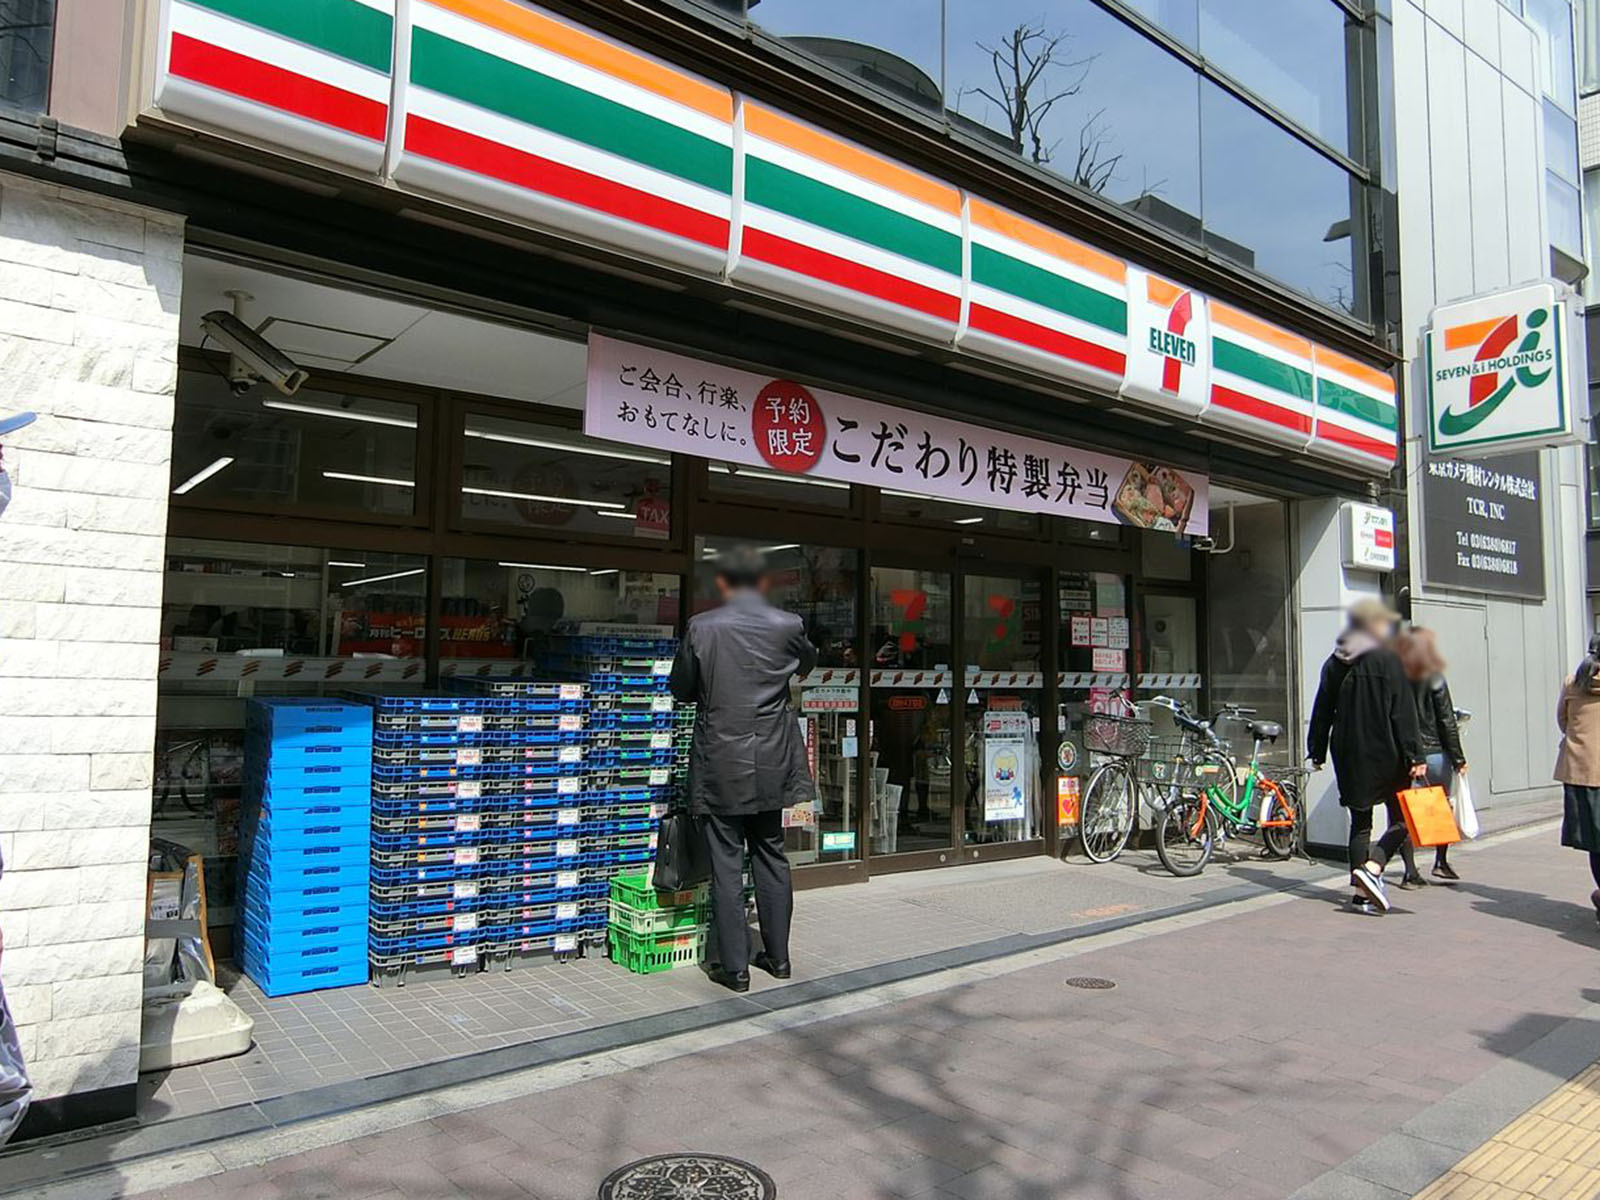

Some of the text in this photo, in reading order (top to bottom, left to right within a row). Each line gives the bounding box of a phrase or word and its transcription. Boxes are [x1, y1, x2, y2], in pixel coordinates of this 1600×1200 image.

[1488, 349, 1552, 371] HOLDINGS
[618, 363, 748, 412] ご会合、行楽、
[617, 400, 747, 447] おもてなしに。
[764, 397, 811, 425] 予約
[767, 428, 815, 457] 限定
[832, 416, 1109, 511] こだわり特製弁当
[1489, 502, 1505, 520] INC
[1456, 531, 1469, 546] Tel
[1456, 552, 1470, 567] Fax
